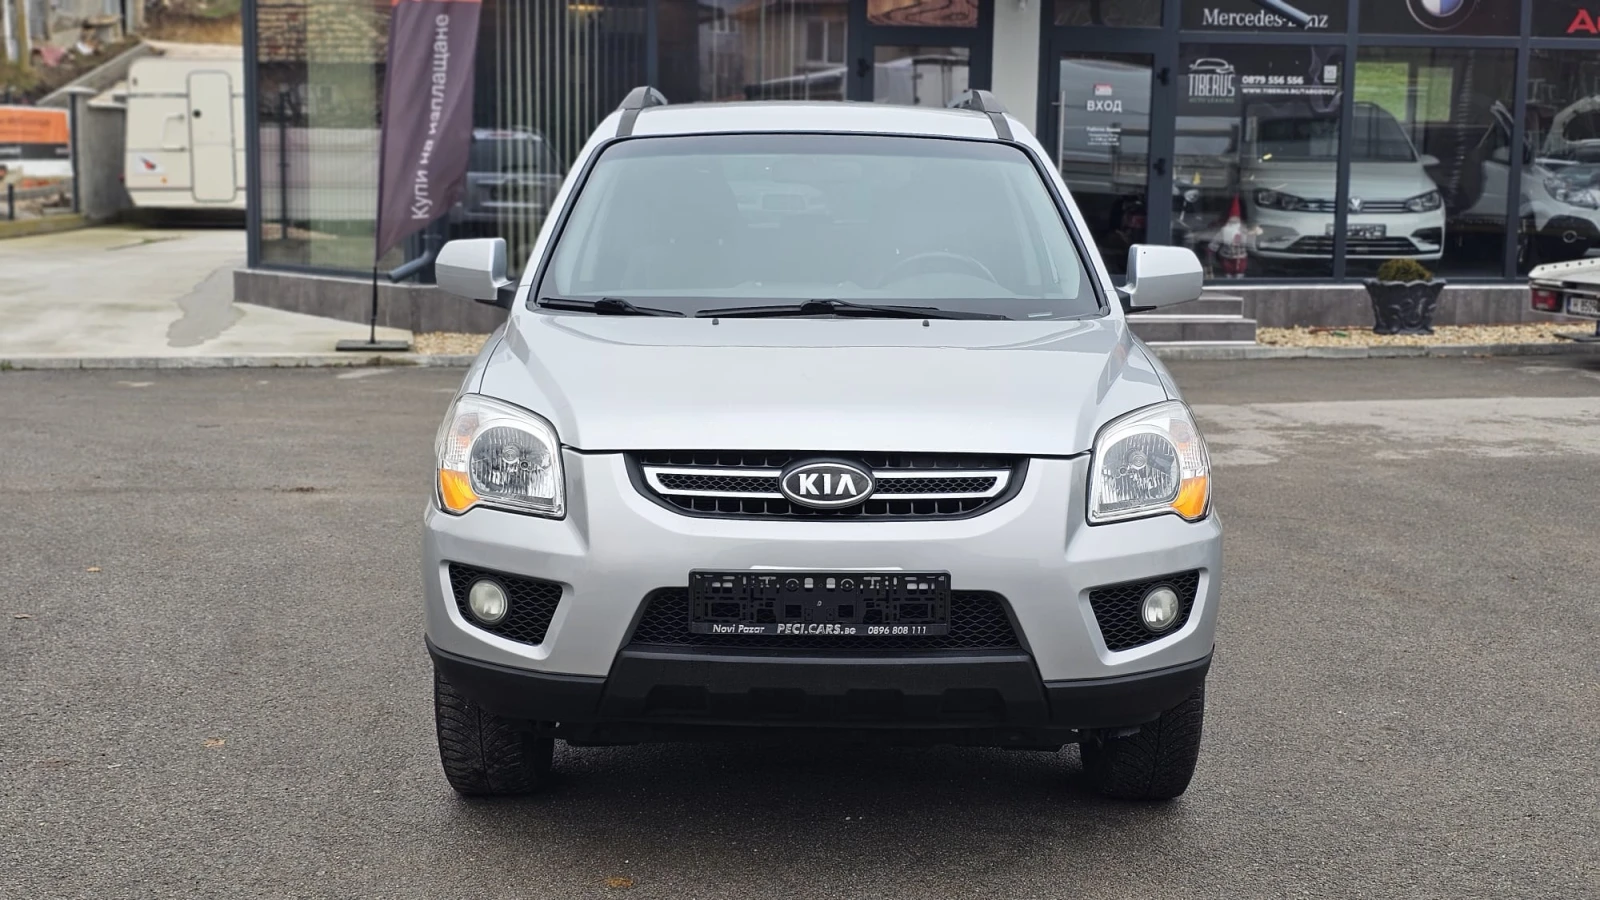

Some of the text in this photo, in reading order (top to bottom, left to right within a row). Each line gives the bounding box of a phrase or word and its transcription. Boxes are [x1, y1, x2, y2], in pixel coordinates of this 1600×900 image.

[1201, 8, 1328, 27] Mercedes-nz
[1566, 8, 1600, 34] A
[1188, 74, 1236, 97] TIBERUS
[1241, 75, 1304, 85] 0879 556 556
[1087, 100, 1123, 113] ВХОД
[419, 139, 434, 164] на
[411, 170, 433, 220] Купи
[798, 473, 858, 496] KIA
[713, 624, 736, 633] Novi
[738, 625, 765, 633] Pazar
[867, 626, 890, 635] 0896
[892, 626, 909, 635] 808
[912, 626, 927, 635] 111
